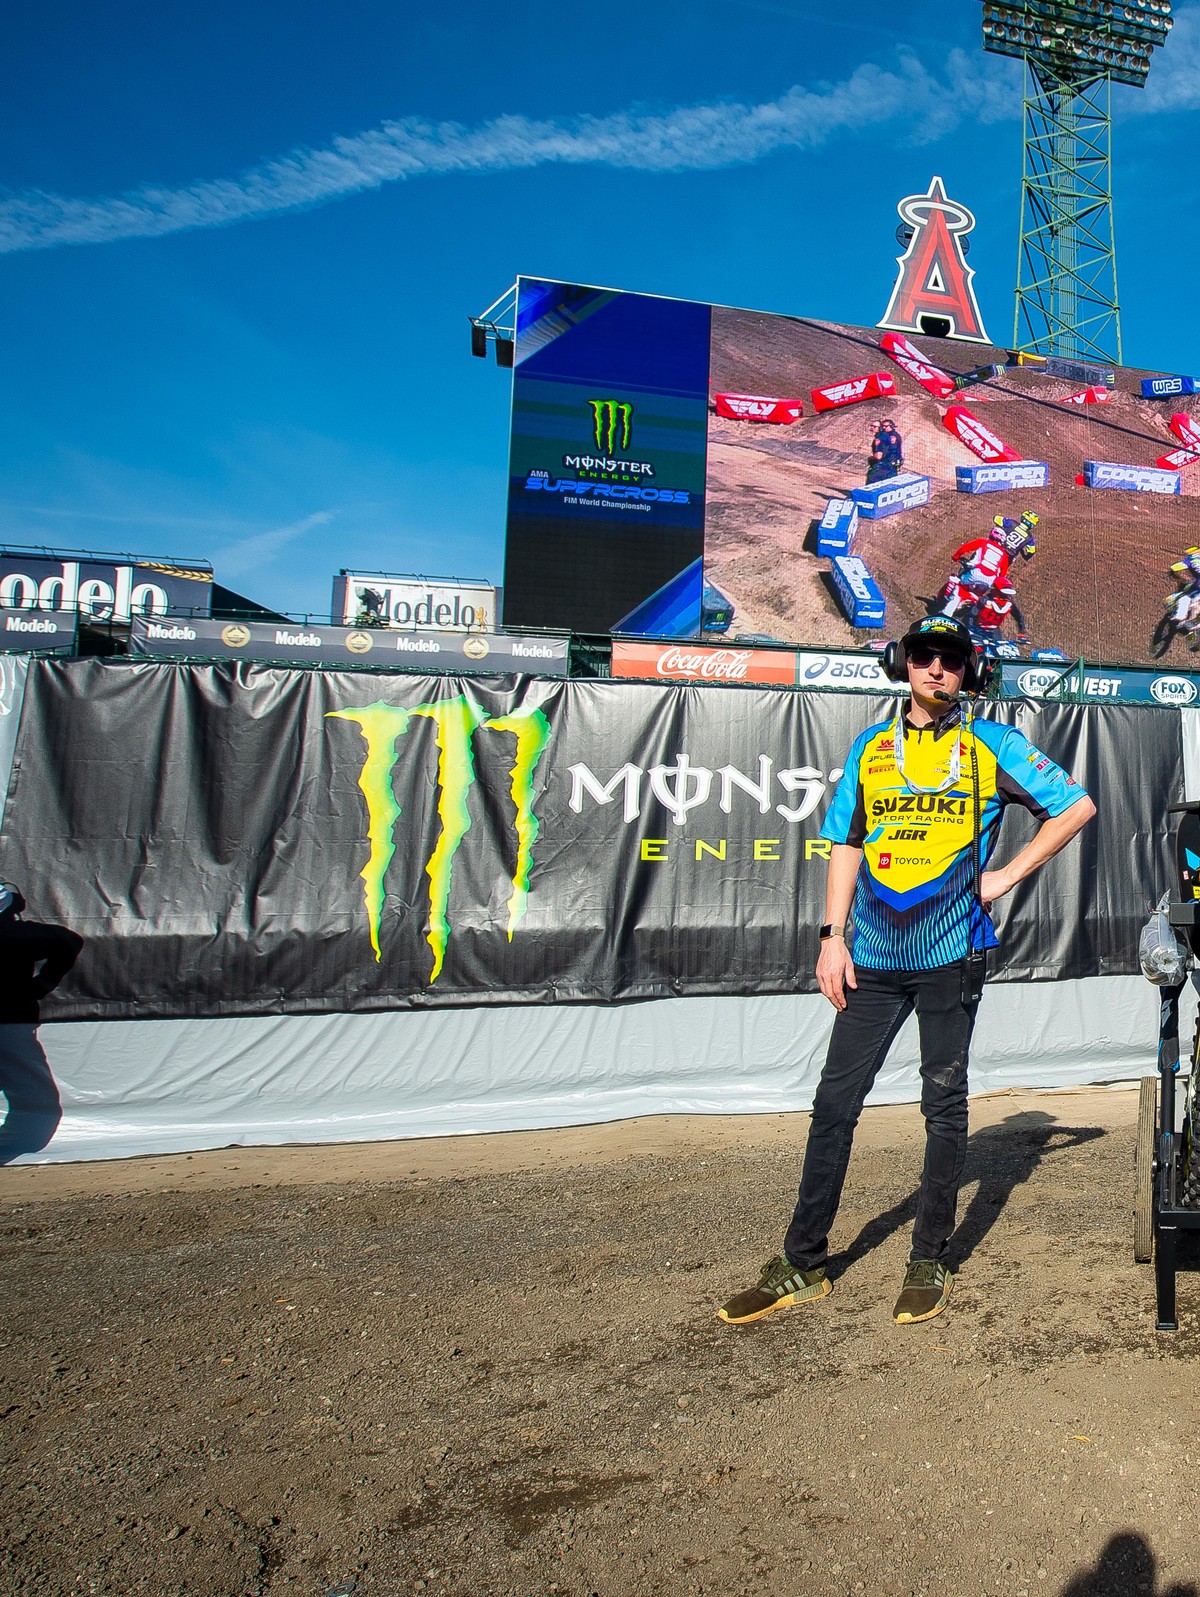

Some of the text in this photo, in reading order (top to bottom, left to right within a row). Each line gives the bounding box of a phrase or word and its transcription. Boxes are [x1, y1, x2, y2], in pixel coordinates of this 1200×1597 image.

[820, 378, 868, 401] FLY
[1152, 378, 1182, 393] WPS
[724, 399, 776, 416] FLY
[955, 417, 1000, 458] FLY
[565, 455, 653, 475] MONSTER
[530, 469, 549, 479] AMA
[579, 470, 640, 481] ENERGY
[976, 466, 1046, 483] COOPER
[1096, 466, 1179, 486] COOPER
[525, 477, 690, 504] SUPERCROSS
[877, 480, 929, 508] COOPER
[564, 496, 651, 511] FIM World Championship
[6, 616, 58, 634] Modelo
[148, 623, 197, 641] Modelo
[275, 630, 322, 648] Modelo
[396, 637, 440, 654] Modelo
[511, 643, 553, 659] Modelo
[656, 647, 754, 679] Coca-Cola
[1029, 674, 1056, 687] FOX
[1070, 676, 1122, 696] WEST
[1161, 681, 1186, 695] FOX
[1161, 693, 1188, 701] SPORTS
[872, 796, 966, 816] SUZUKI
[872, 815, 964, 825] FACTORY RACING
[888, 829, 927, 841] JGR
[895, 857, 931, 865] TOYOTA
